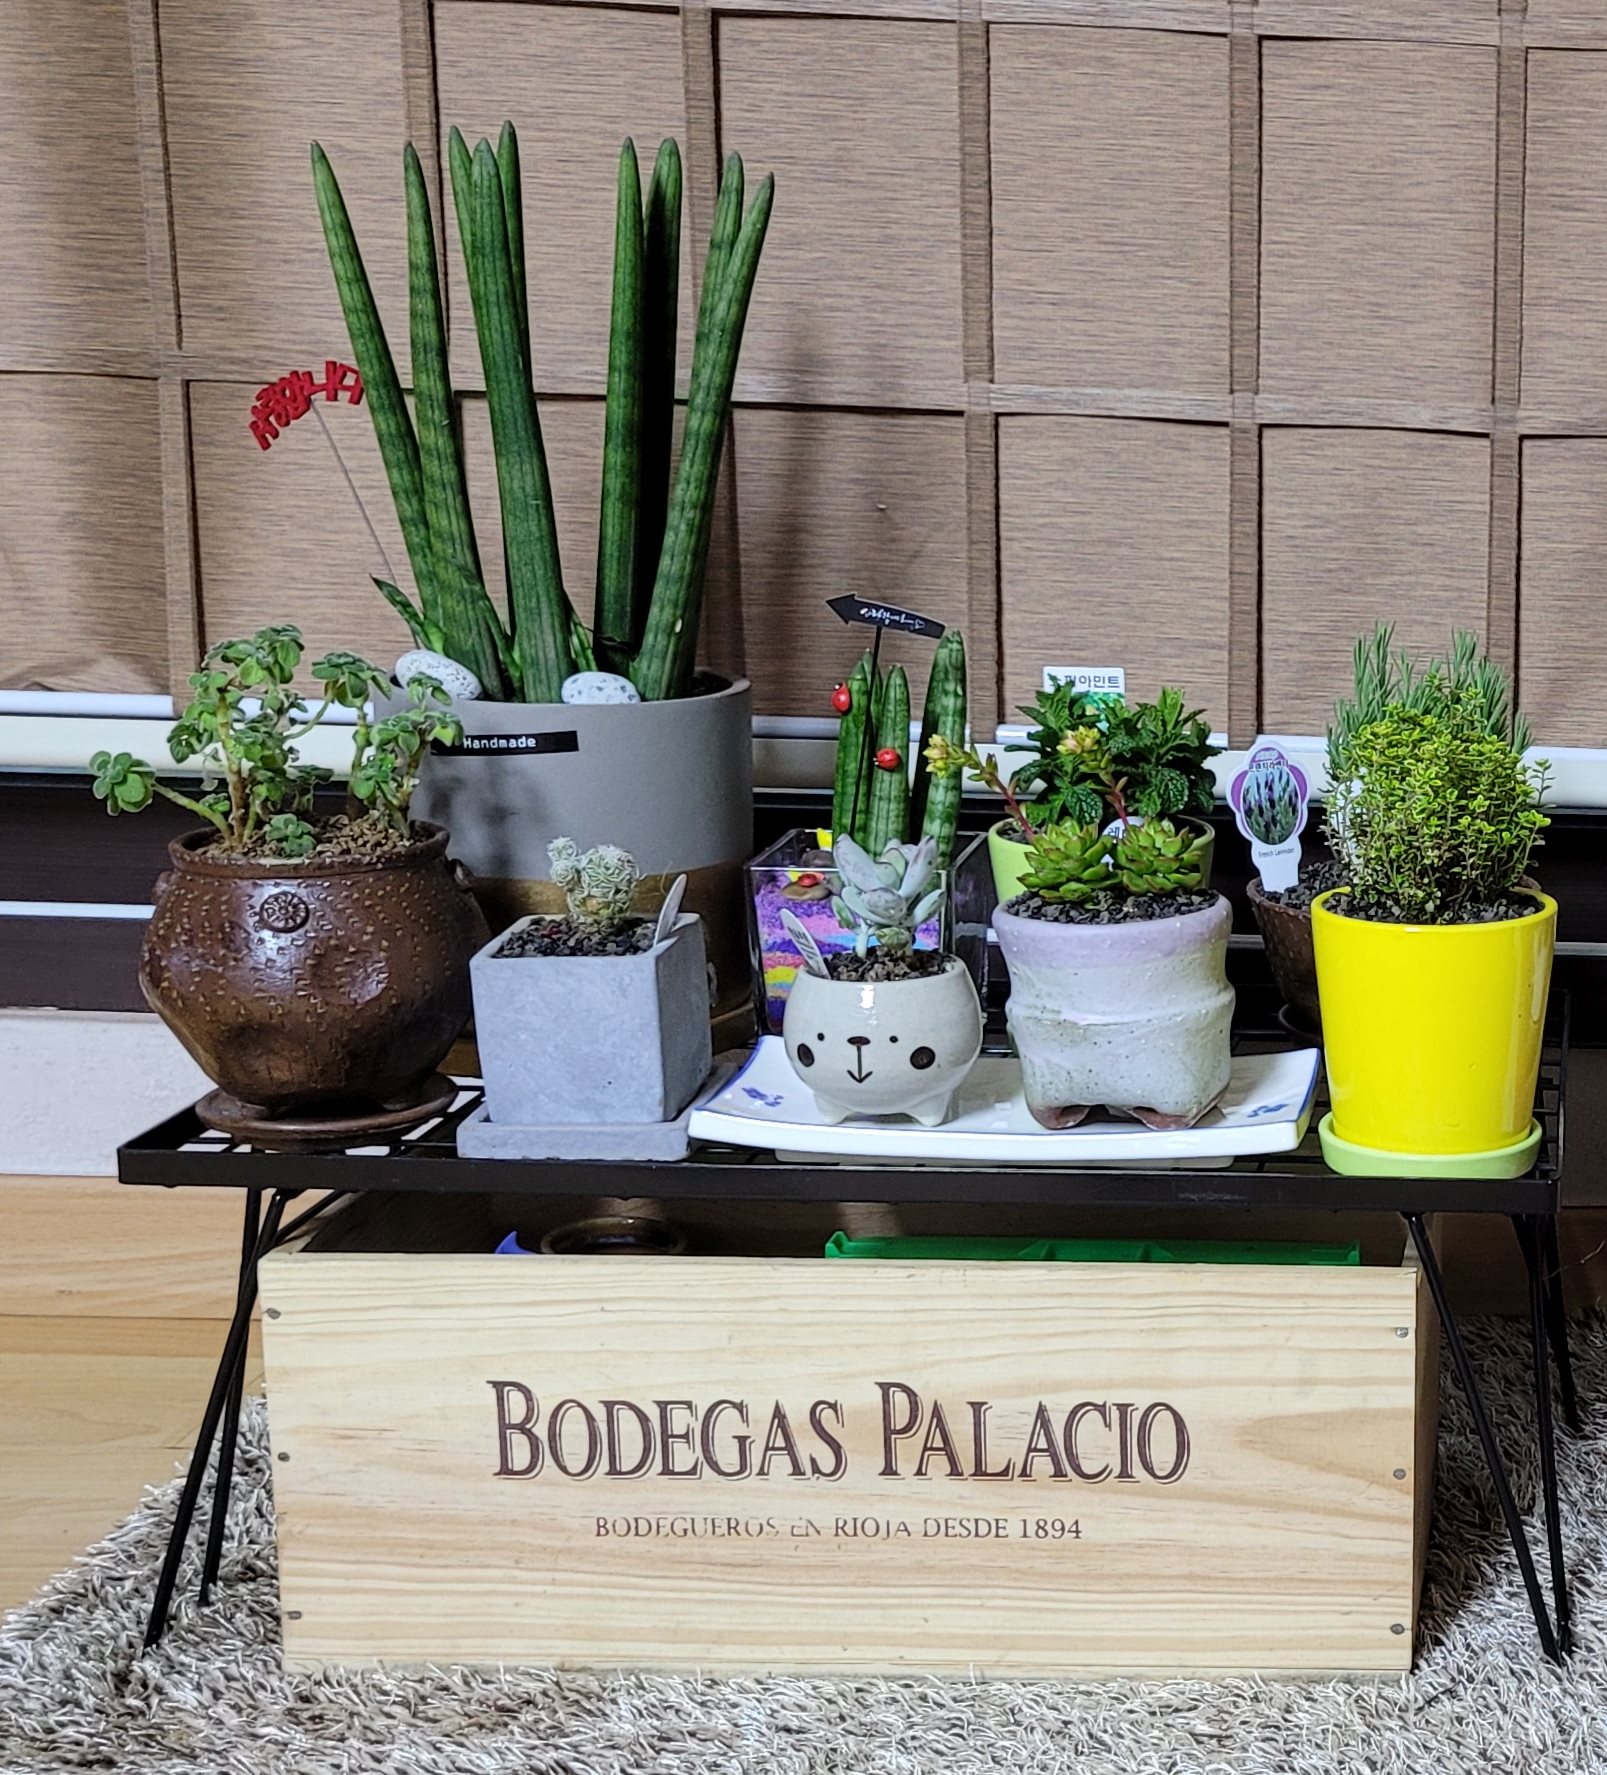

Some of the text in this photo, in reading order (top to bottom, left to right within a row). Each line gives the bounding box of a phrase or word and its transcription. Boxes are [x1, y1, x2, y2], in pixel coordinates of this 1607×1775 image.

[1049, 674, 1121, 689] 피아민트
[462, 735, 537, 750] Handmade
[486, 1380, 1192, 1485] BODEGAS PALACIO
[595, 1516, 780, 1538] BODEGUEROS
[833, 1516, 912, 1541] RIOJA
[922, 1517, 1010, 1539] DESDE
[1018, 1517, 1083, 1541] 1894
